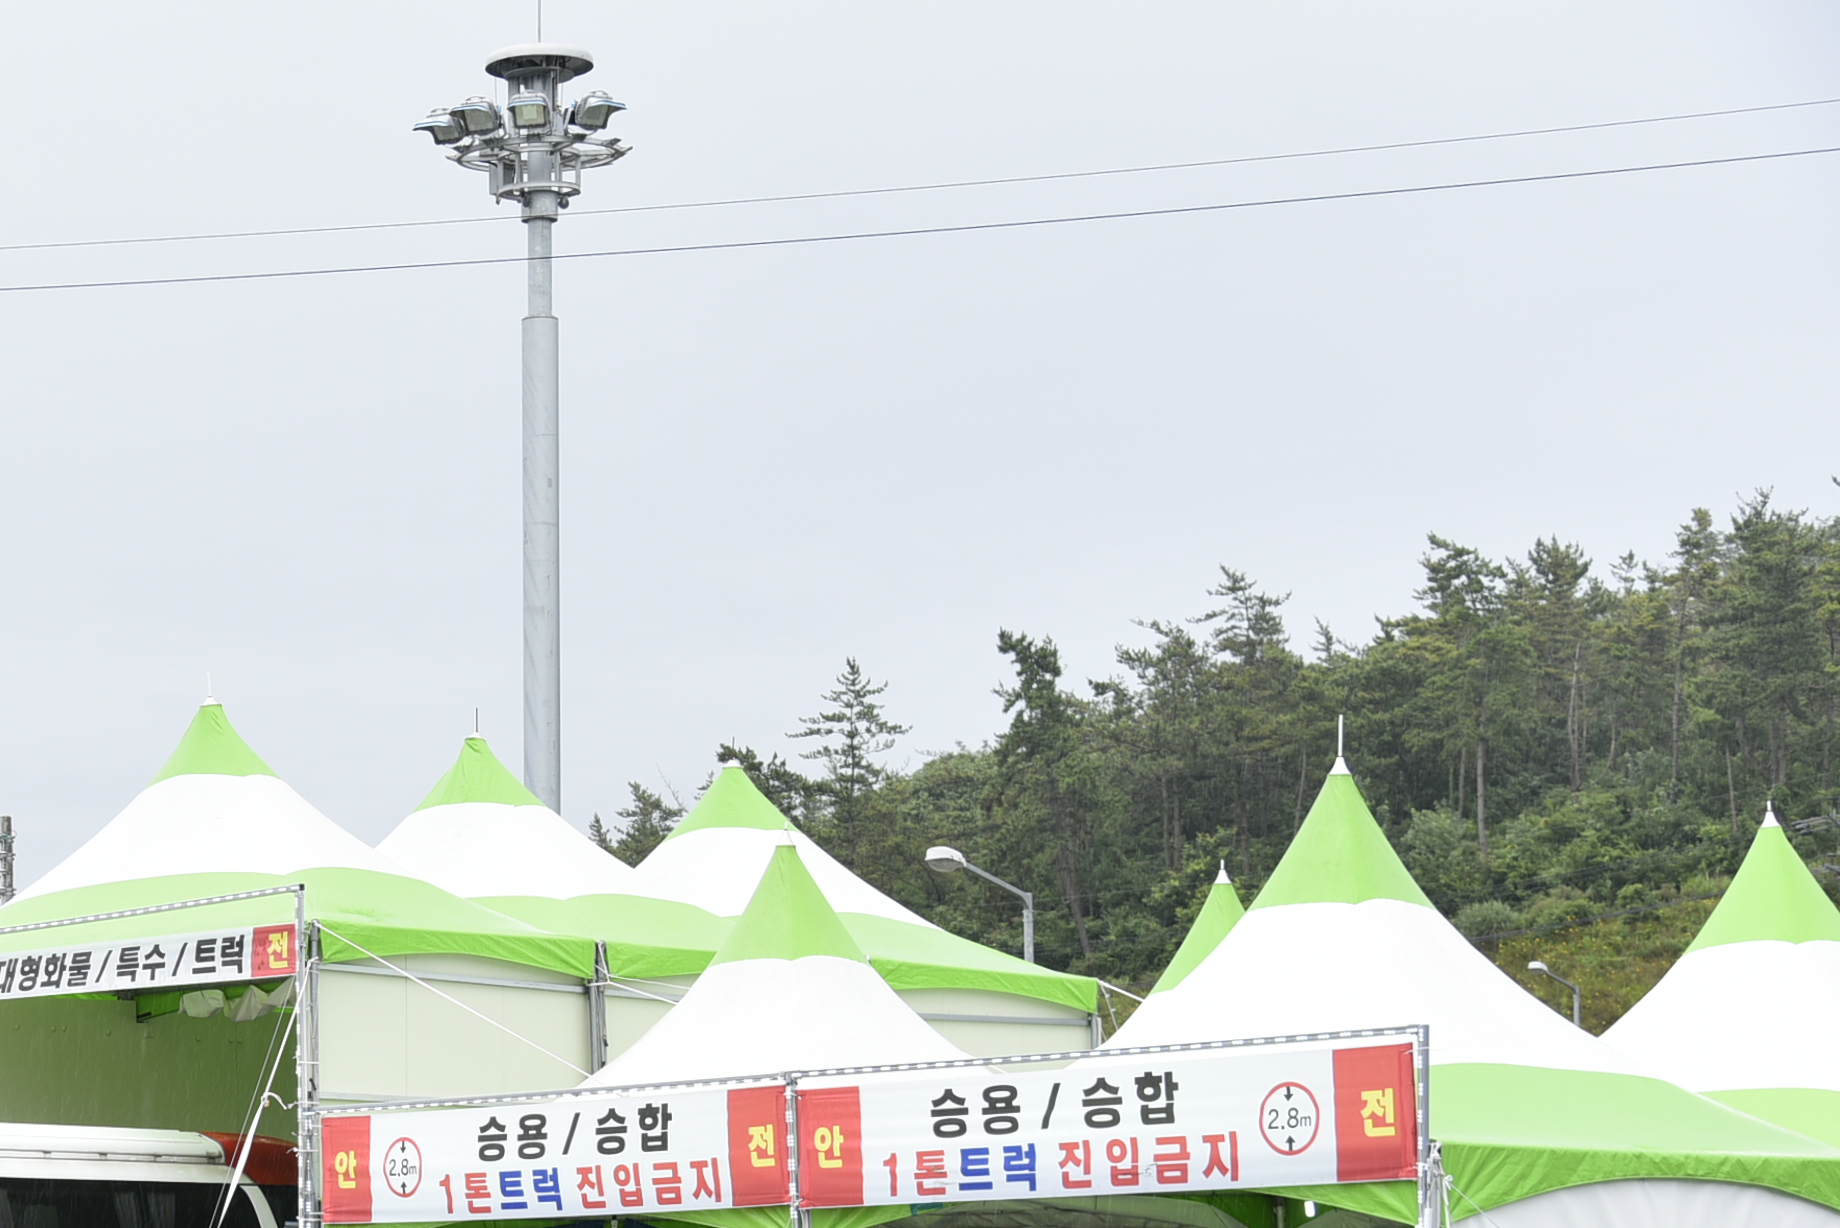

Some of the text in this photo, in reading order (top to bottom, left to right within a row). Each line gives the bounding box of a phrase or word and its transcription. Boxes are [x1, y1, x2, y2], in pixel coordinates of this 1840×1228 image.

[265, 931, 290, 969] 전
[1267, 1107, 1312, 1131] 2.8m
[1360, 1088, 1397, 1138] 전
[388, 1158, 418, 1178] 2.8m
[748, 1124, 777, 1169] 전
[813, 1124, 844, 1169] 안
[1057, 1130, 1240, 1190] 진입금지
[334, 1150, 357, 1190] 안
[576, 1156, 723, 1210] 진입금지
